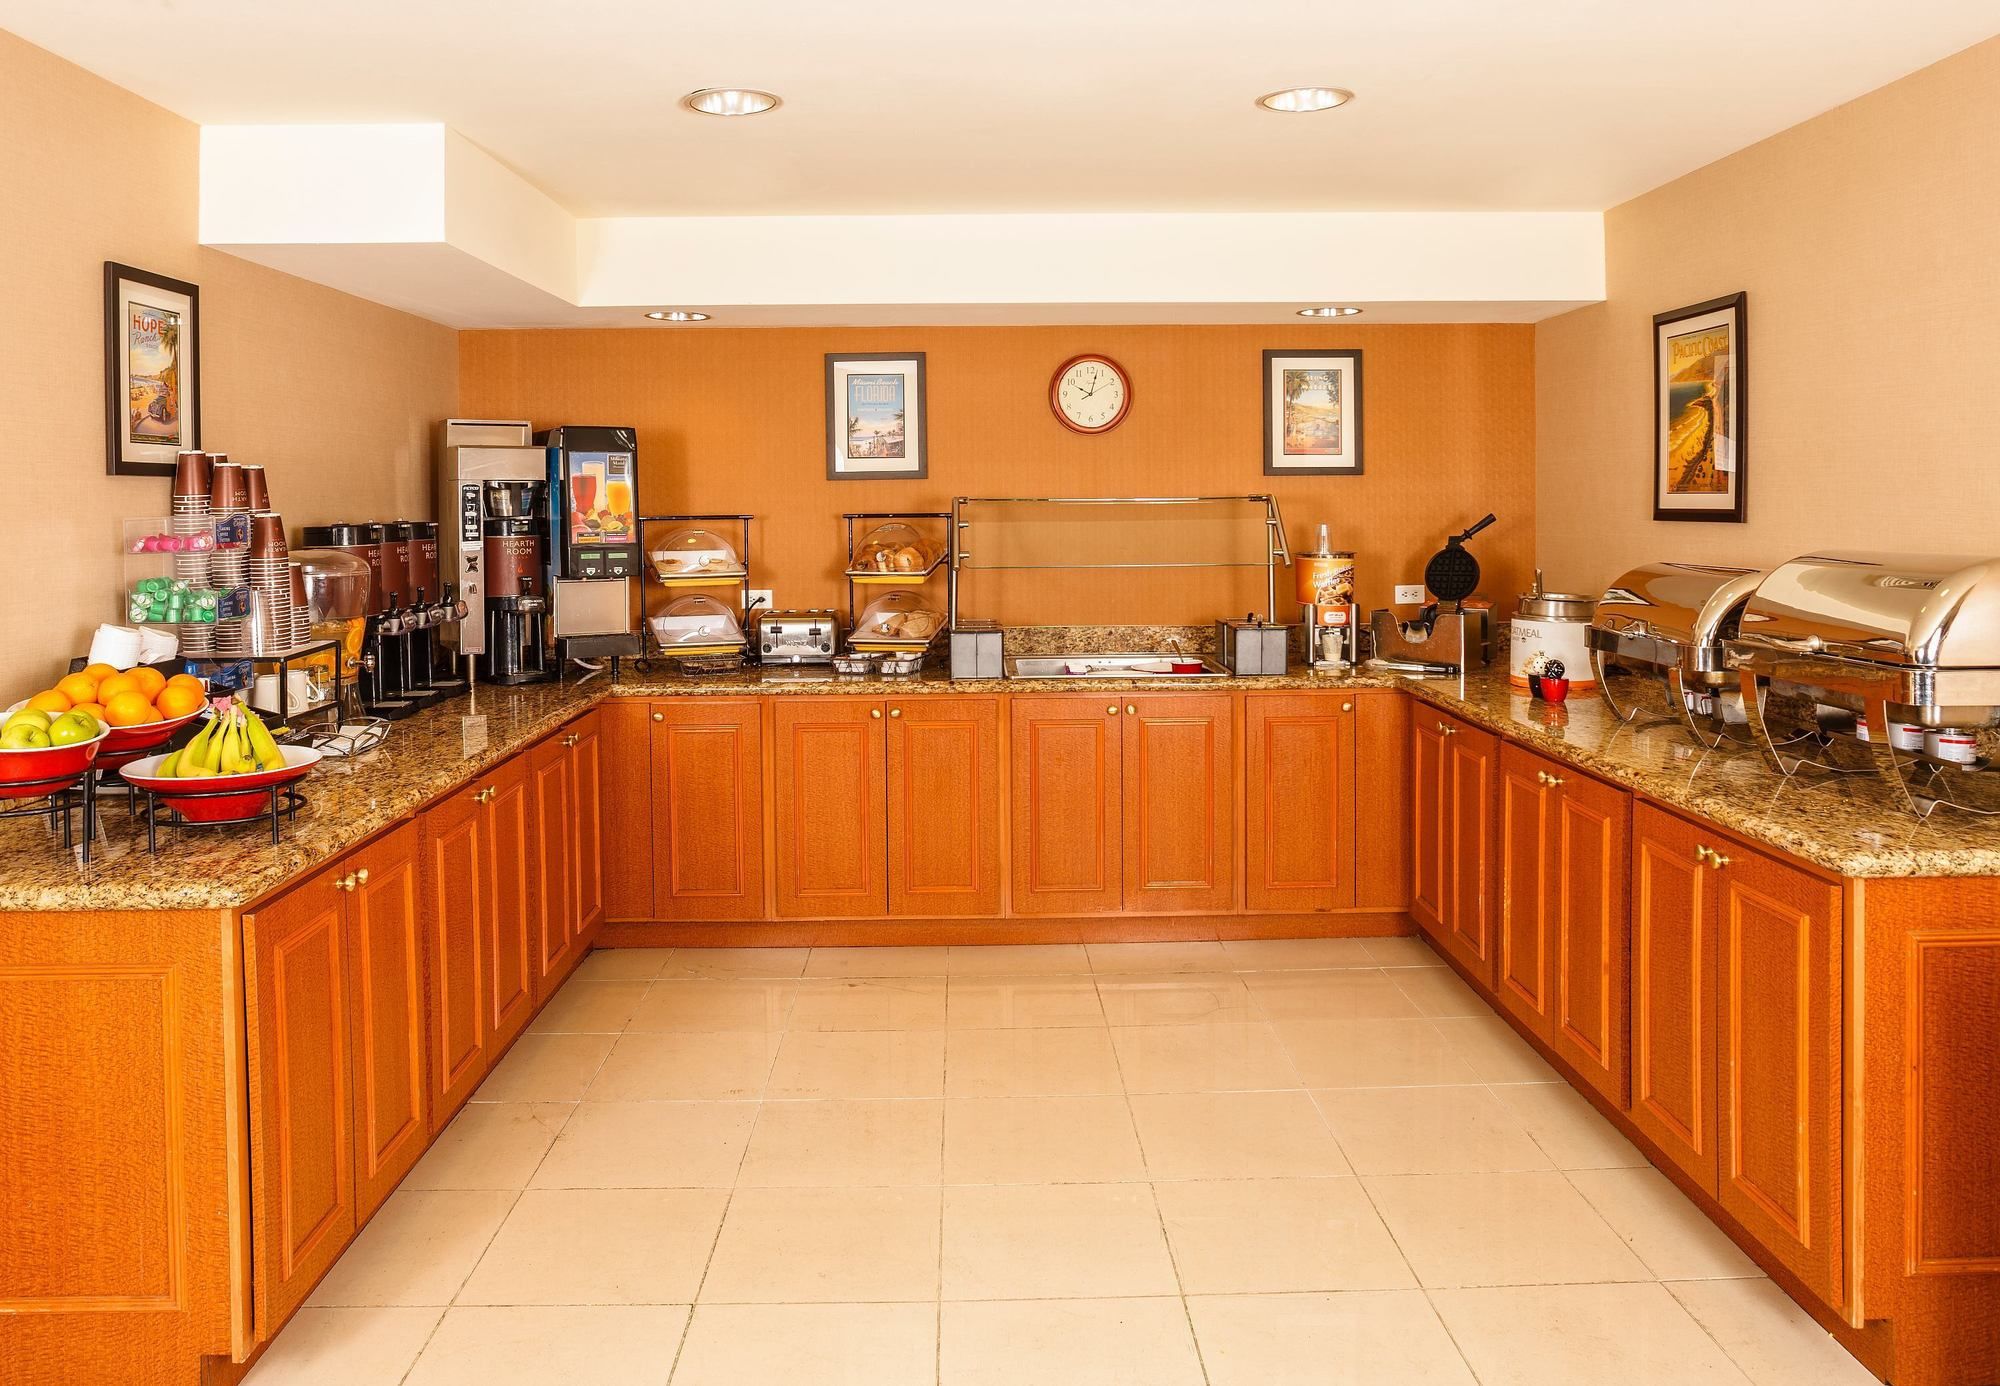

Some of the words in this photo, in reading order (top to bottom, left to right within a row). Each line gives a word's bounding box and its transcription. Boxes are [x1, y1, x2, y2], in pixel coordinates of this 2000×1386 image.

[133, 313, 164, 337] HOPE
[1672, 340, 1702, 364] PACIFIC
[1703, 335, 1728, 358] COAST
[1075, 369, 1082, 377] 11
[1086, 366, 1095, 375] 12
[1067, 378, 1075, 386] 10
[1110, 378, 1115, 386] 2
[855, 385, 897, 402] FLORIDA
[1062, 390, 1068, 398] 9
[1113, 390, 1119, 398] 3
[1076, 411, 1081, 419] 7
[1100, 411, 1106, 419] 5
[502, 540, 536, 548] HEARTH
[368, 549, 382, 558] HEA
[396, 546, 409, 554] HEA
[506, 547, 533, 555] ROOM
[371, 558, 382, 567] RO
[1312, 569, 1333, 579] Fresh
[1312, 577, 1340, 589] Waffles
